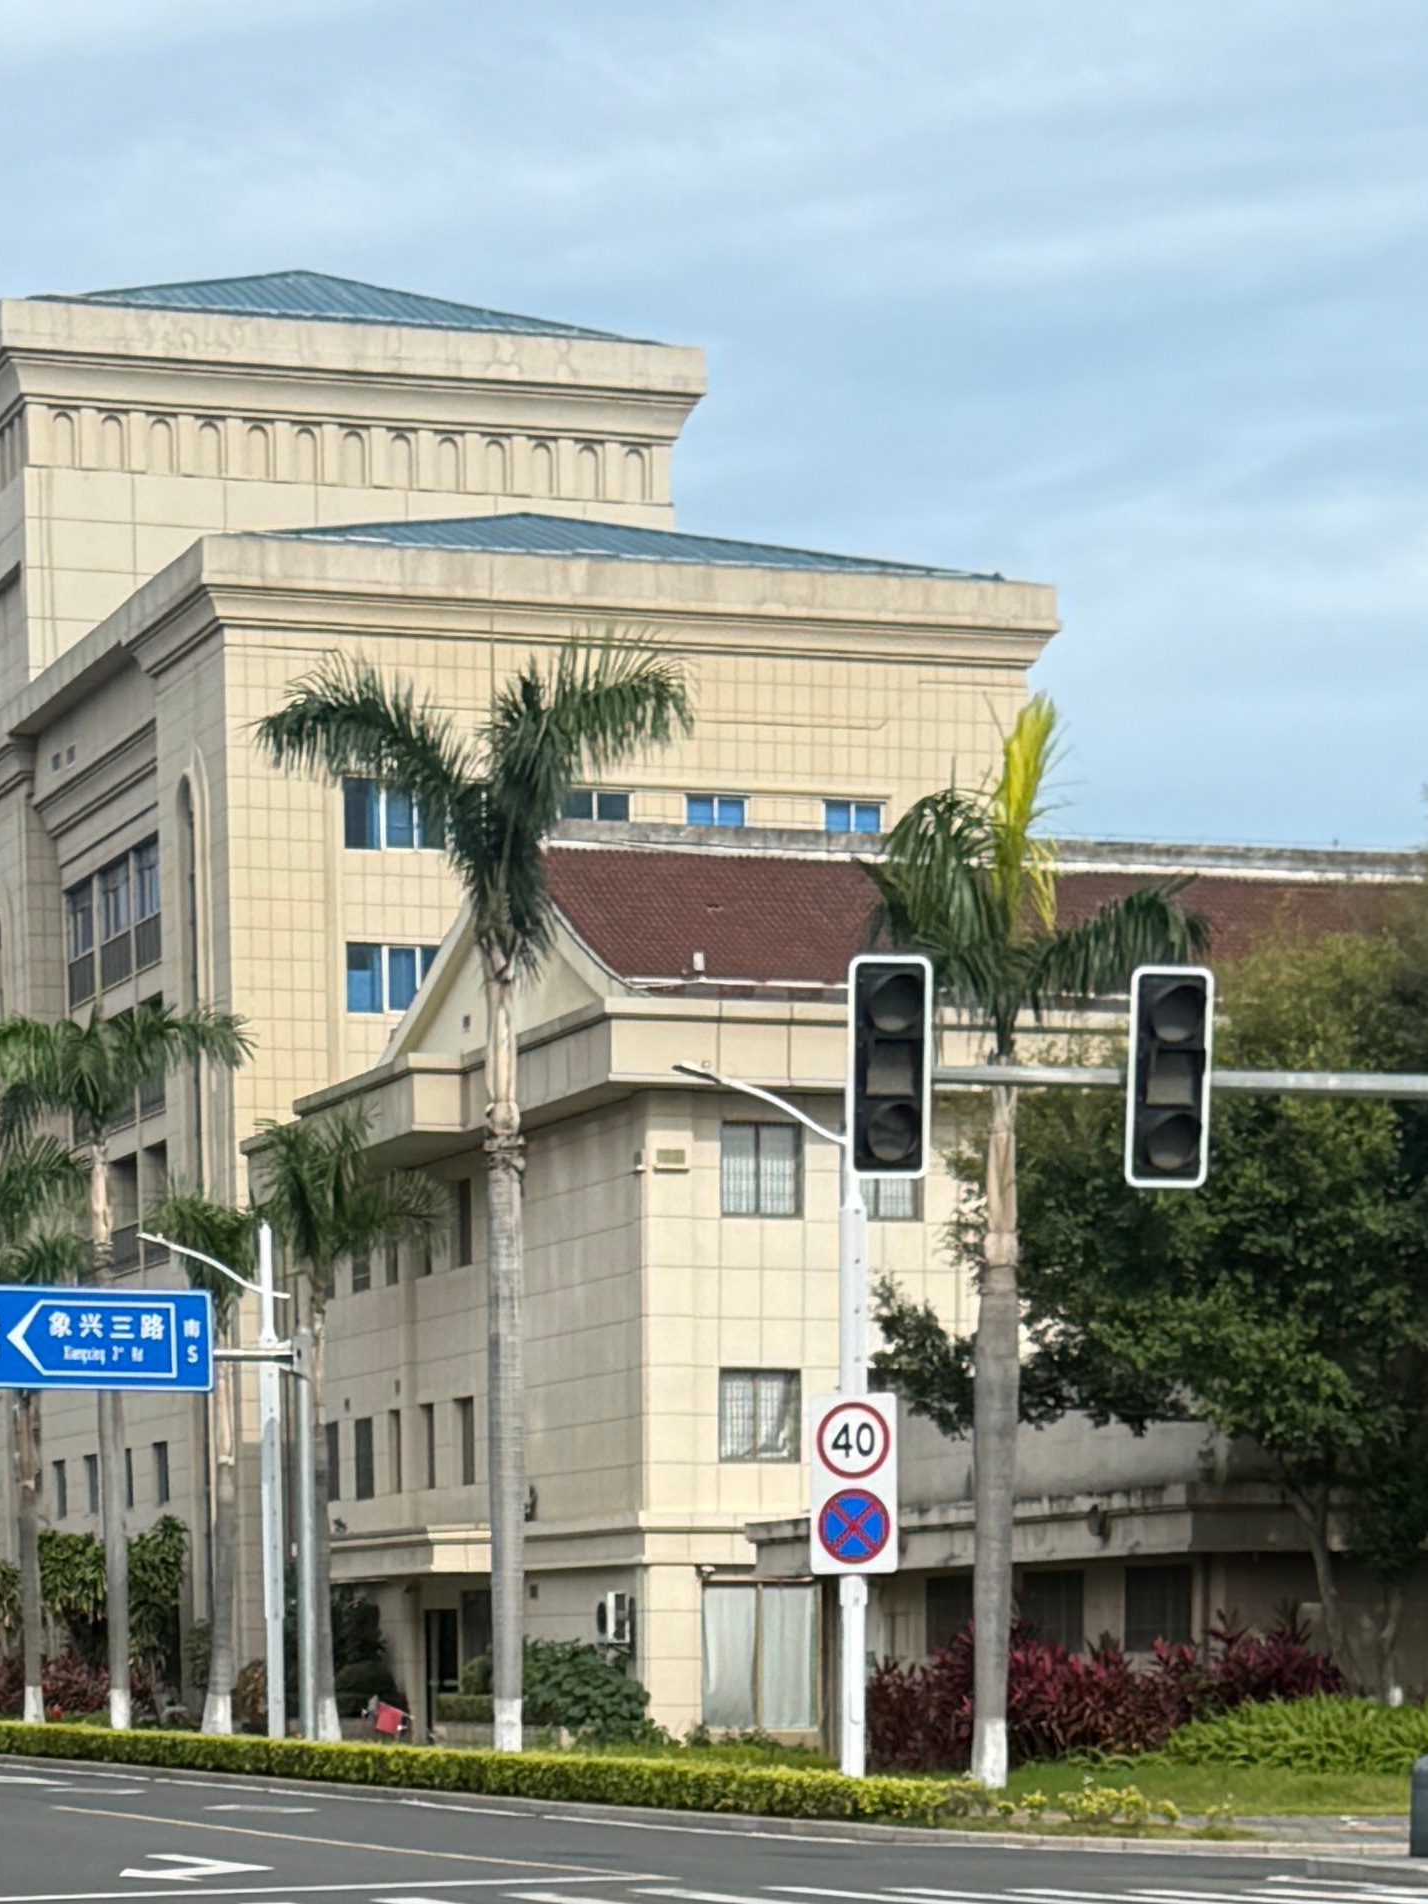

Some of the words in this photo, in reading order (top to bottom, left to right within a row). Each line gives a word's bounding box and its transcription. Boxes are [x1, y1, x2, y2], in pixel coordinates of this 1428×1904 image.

[48, 1311, 165, 1341] 象兴三路
[183, 1319, 200, 1338] 南
[187, 1345, 199, 1364] S
[831, 1422, 876, 1458] 40
